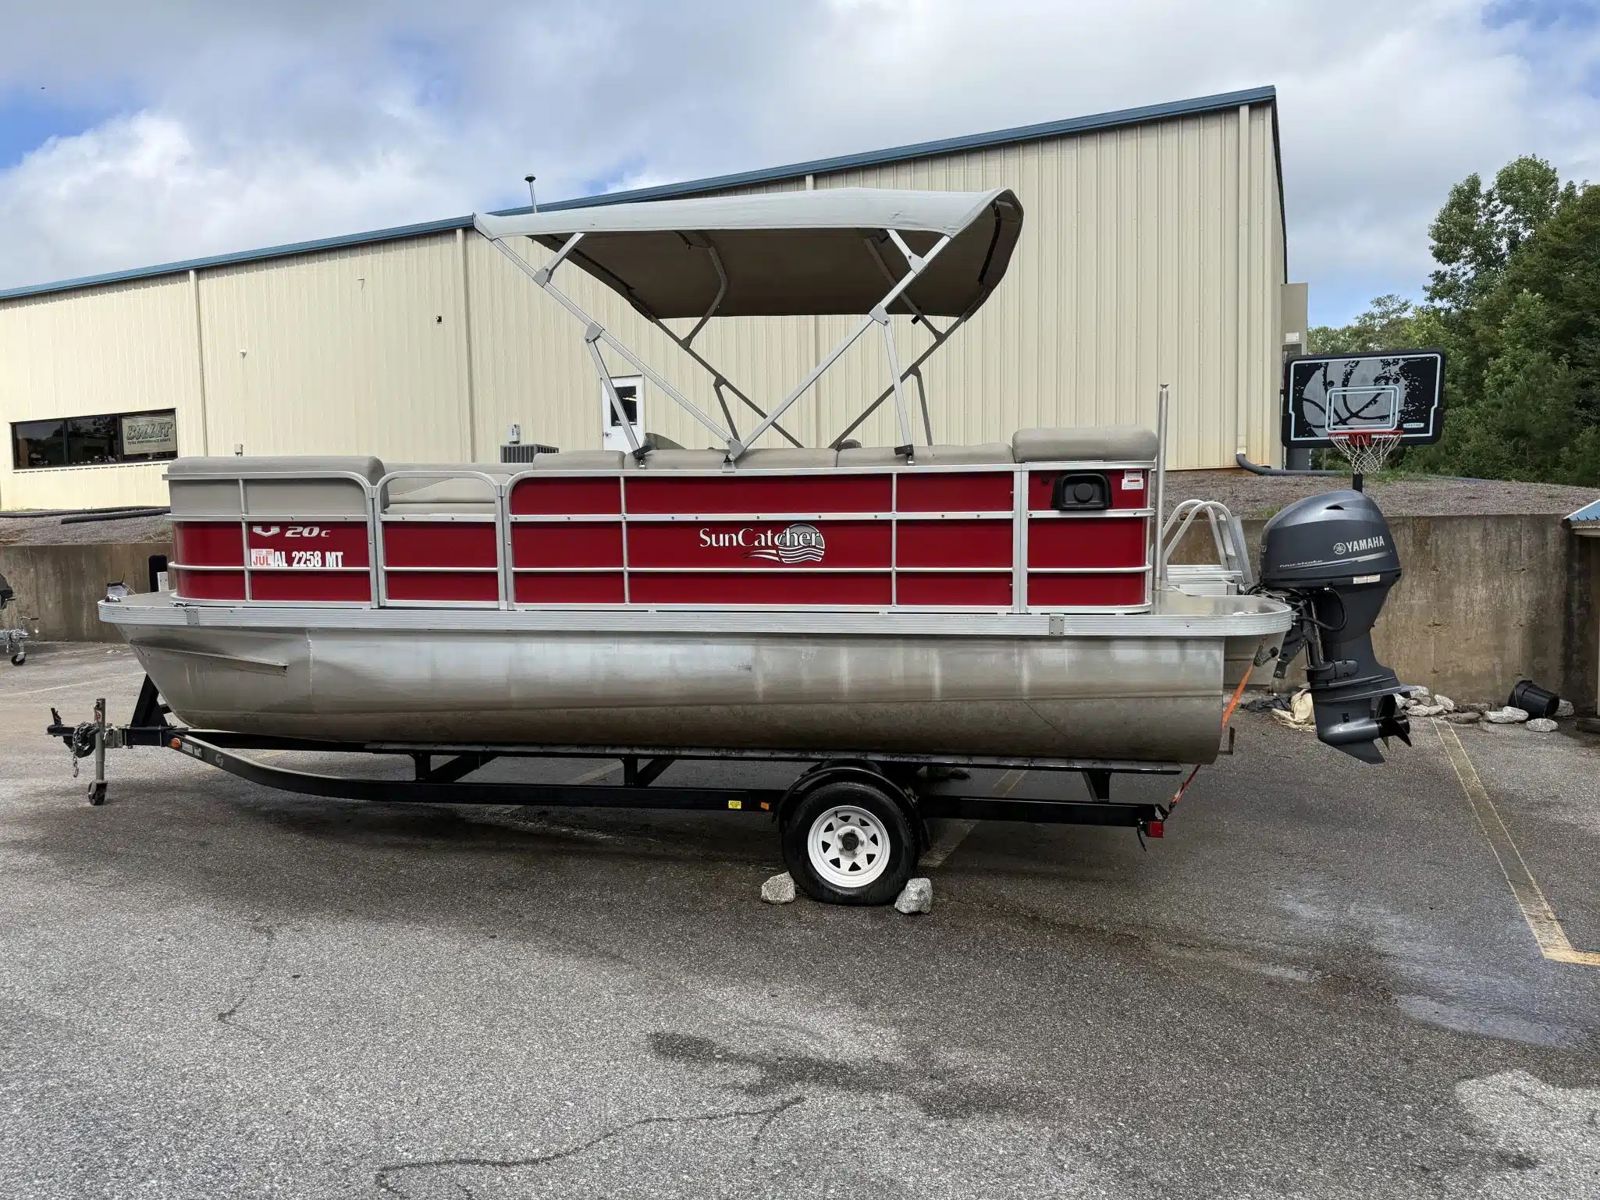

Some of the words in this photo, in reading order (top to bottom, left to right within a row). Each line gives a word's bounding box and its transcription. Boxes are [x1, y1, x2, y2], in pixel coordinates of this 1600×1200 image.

[699, 527, 820, 547] SunCatcher
[1346, 536, 1385, 552] YAMAHA
[253, 555, 271, 566] JUL
[274, 551, 288, 567] AL
[292, 551, 322, 567] 2258
[325, 551, 344, 567] MT
